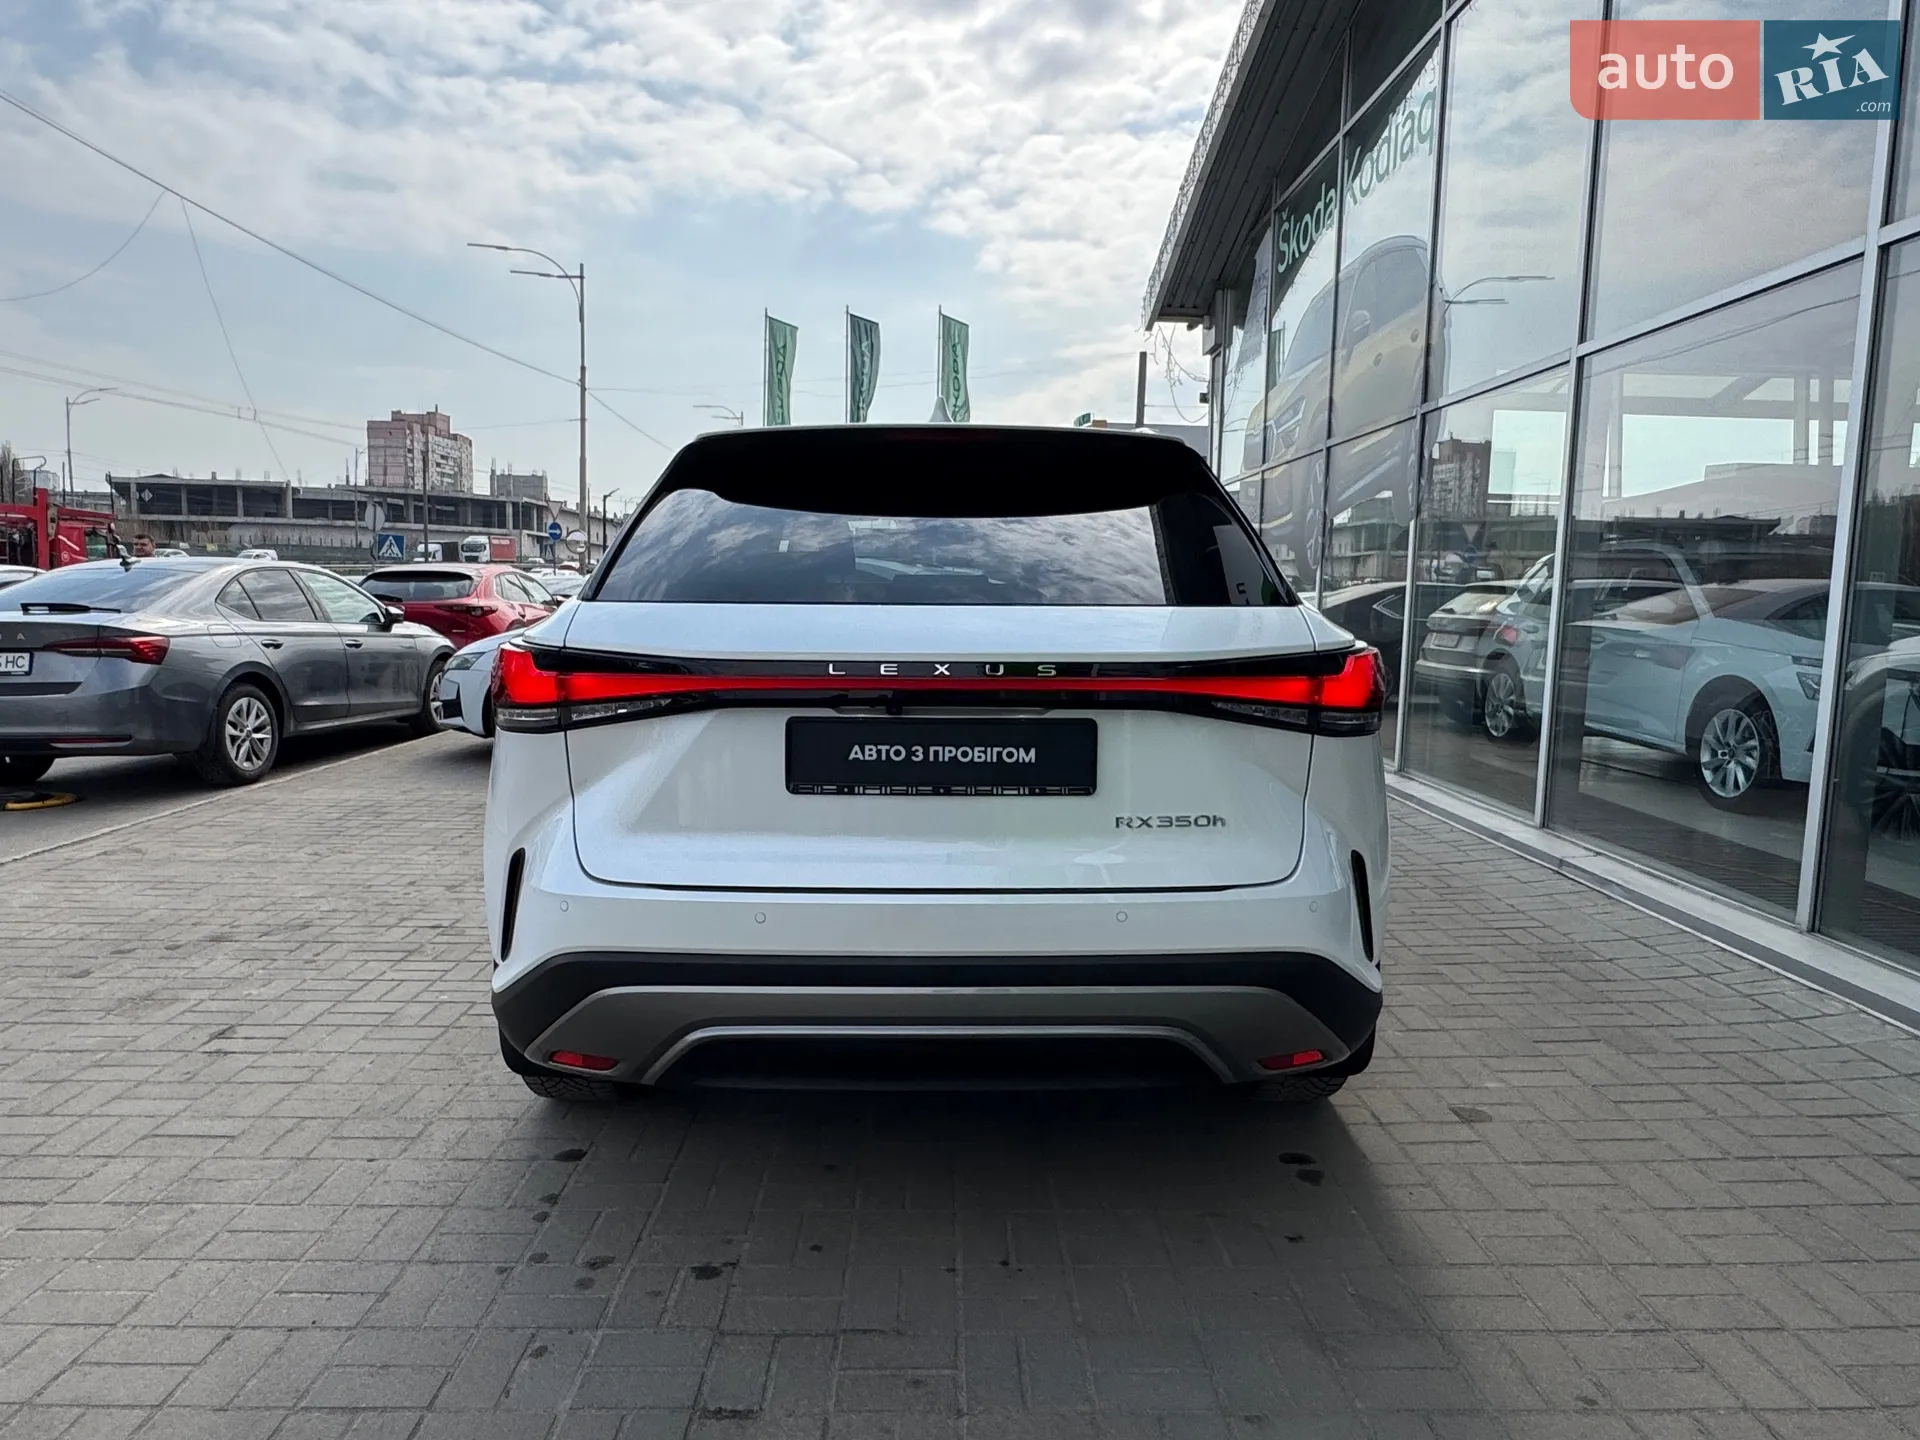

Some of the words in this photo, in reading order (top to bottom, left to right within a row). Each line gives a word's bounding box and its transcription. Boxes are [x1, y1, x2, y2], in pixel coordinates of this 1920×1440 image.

[1277, 182, 1338, 274] Škoda
[1345, 86, 1438, 206] Kodiaq
[828, 663, 1057, 677] LEXUS
[848, 744, 907, 762] АВТО
[929, 746, 1037, 763] ПРОБІГОМ
[1114, 814, 1227, 829] RX350h
